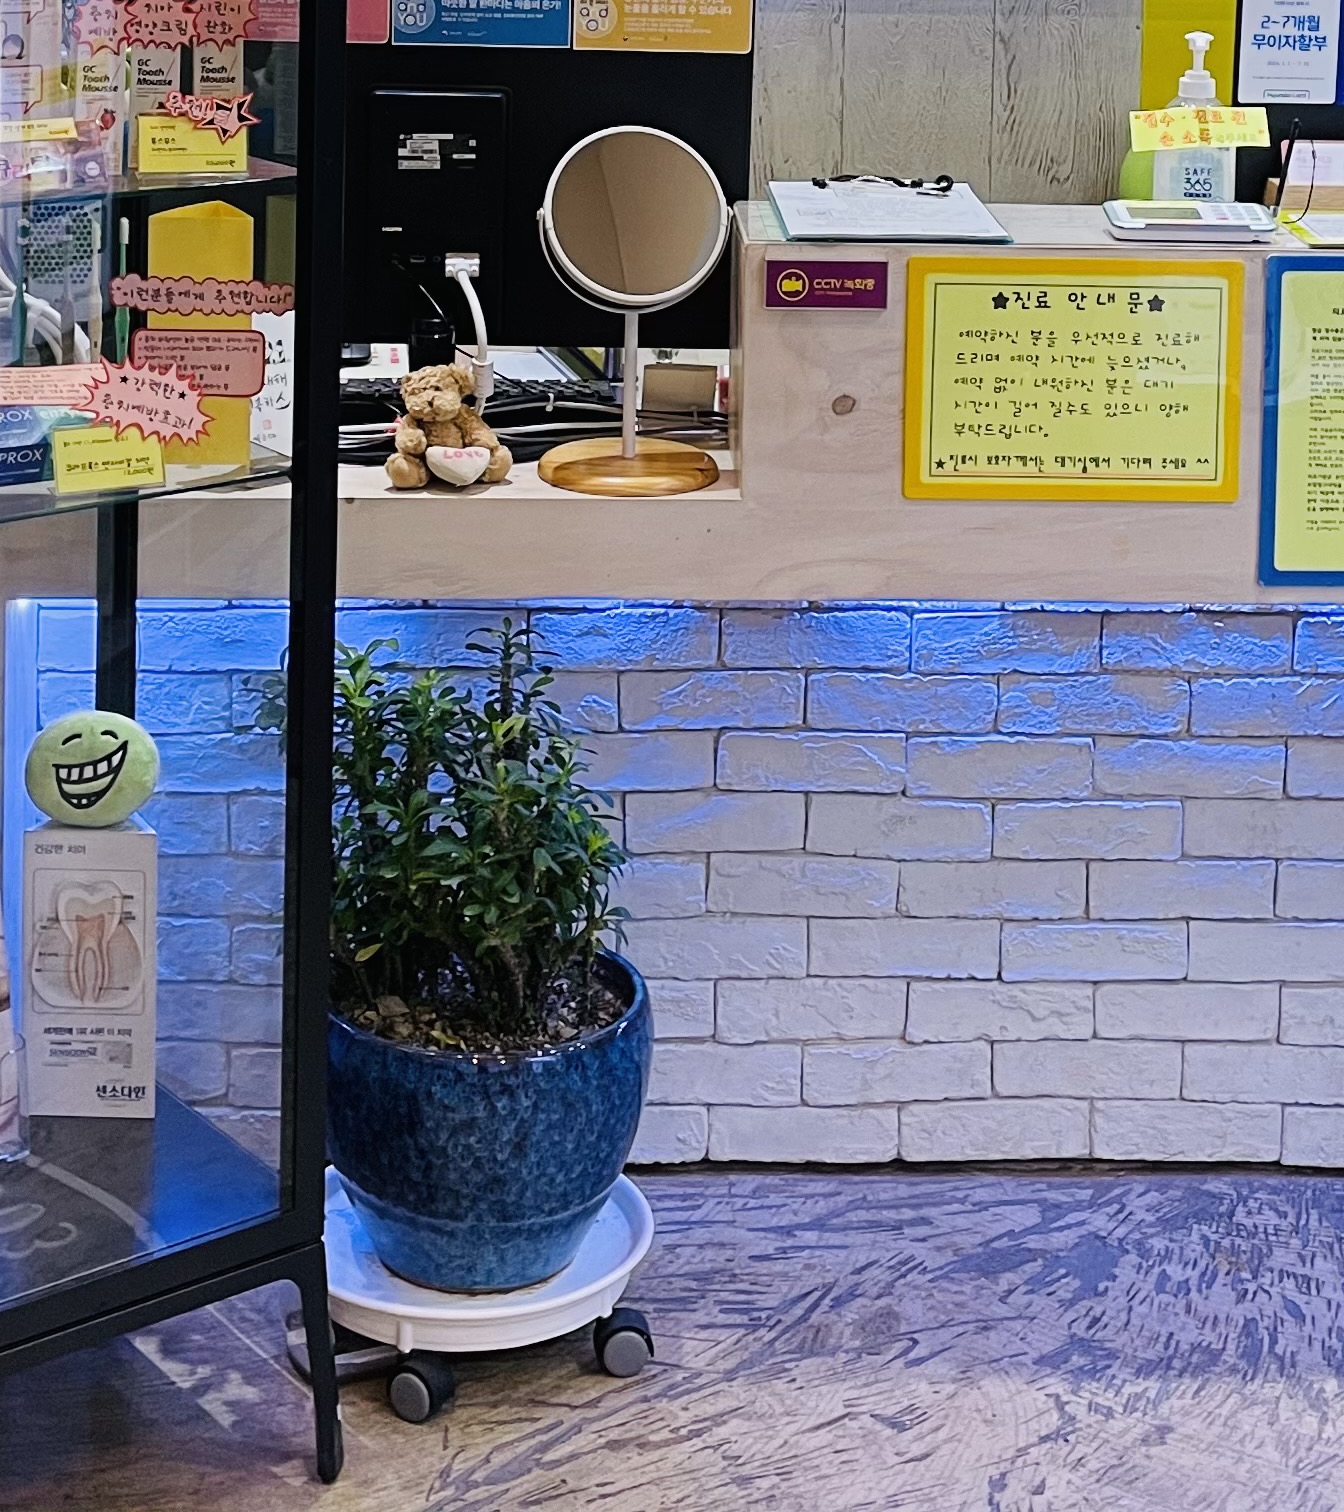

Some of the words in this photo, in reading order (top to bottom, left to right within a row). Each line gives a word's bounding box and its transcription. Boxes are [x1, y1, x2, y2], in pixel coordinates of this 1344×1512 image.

[144, 4, 173, 14] 치아
[1261, 15, 1320, 32] 2~7개월
[1251, 34, 1328, 52] 무이자할부
[82, 65, 96, 73] GC
[200, 57, 213, 65] GC
[137, 68, 164, 76] Tooth
[200, 66, 228, 74] Tooth
[136, 78, 173, 87] Mousse
[200, 75, 236, 84] Mousse
[1184, 167, 1212, 176] SAFE
[1183, 177, 1212, 191] 365
[813, 279, 842, 288] CCTV
[1013, 291, 1051, 310] 진료
[959, 330, 1019, 344] 예약하신
[1030, 330, 1058, 347] 분을
[1071, 331, 1143, 346] 우선적으로
[1156, 332, 1200, 346] 진료해
[955, 352, 1000, 365] 드리며
[1010, 355, 1040, 367] 예약
[1050, 355, 1095, 368] 시간에
[954, 377, 983, 390] 예약
[993, 377, 1023, 394] 없이
[1034, 377, 1094, 393] 내원하신
[1106, 378, 1134, 395] 분은
[1143, 380, 1174, 390] 대기
[954, 401, 997, 414] 시간이
[1008, 400, 1038, 418] 길어
[1049, 400, 1093, 418] 질수도
[1104, 402, 1148, 417] 있으니
[1159, 403, 1189, 418] 양해
[954, 423, 1050, 439] 부탁드립니다.
[95, 1084, 146, 1099] 센소다인
